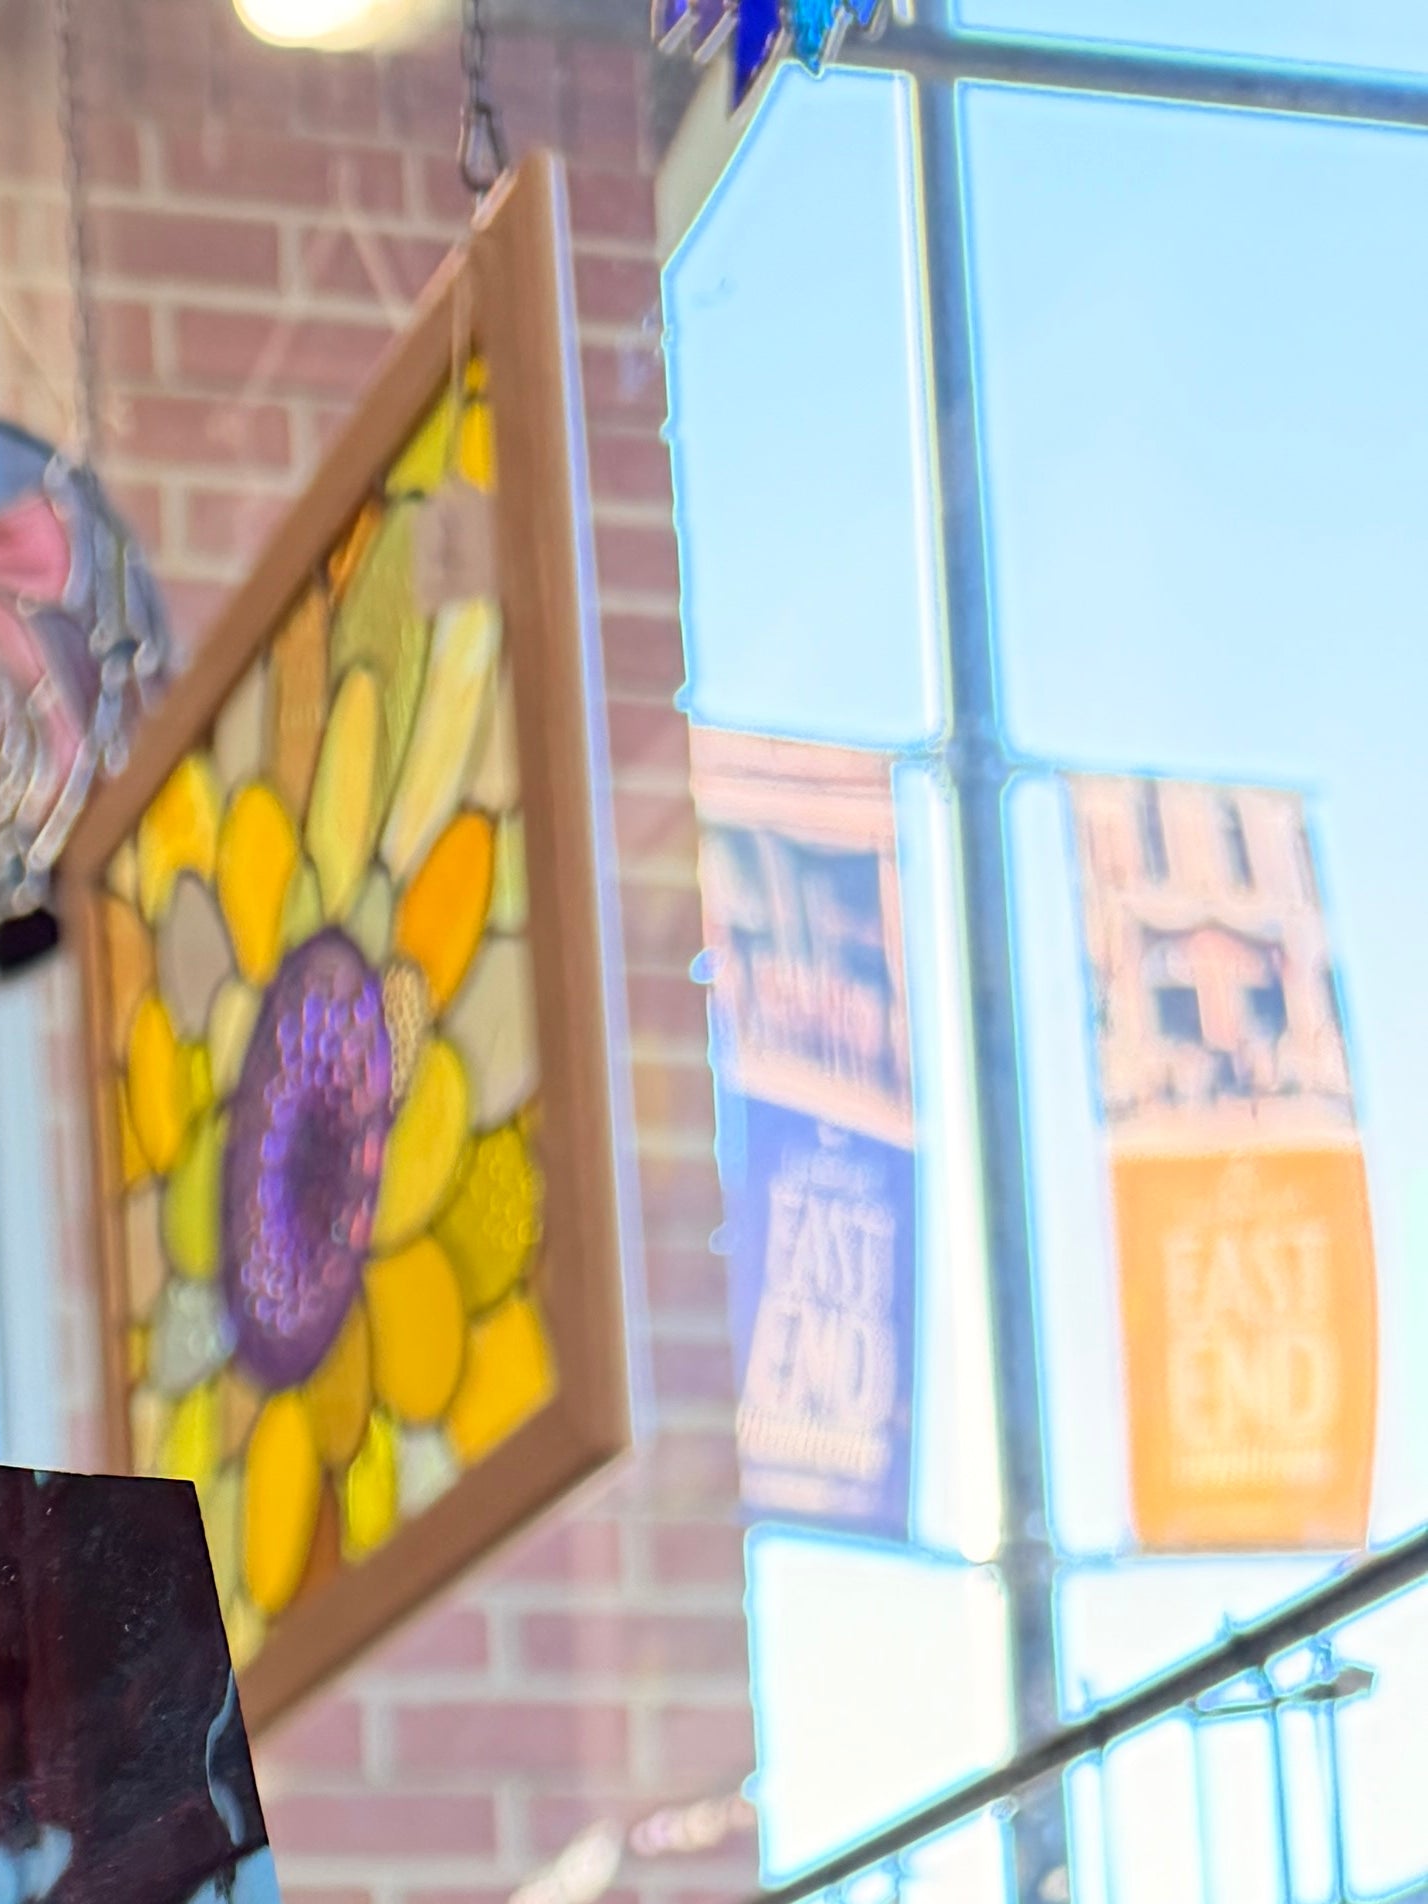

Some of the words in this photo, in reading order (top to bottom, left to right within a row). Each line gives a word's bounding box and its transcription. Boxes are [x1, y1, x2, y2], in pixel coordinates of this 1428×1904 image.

[768, 1182, 896, 1310] EAST
[1164, 1224, 1332, 1328] EAST
[744, 1290, 896, 1424] END
[1166, 1325, 1341, 1450] END
